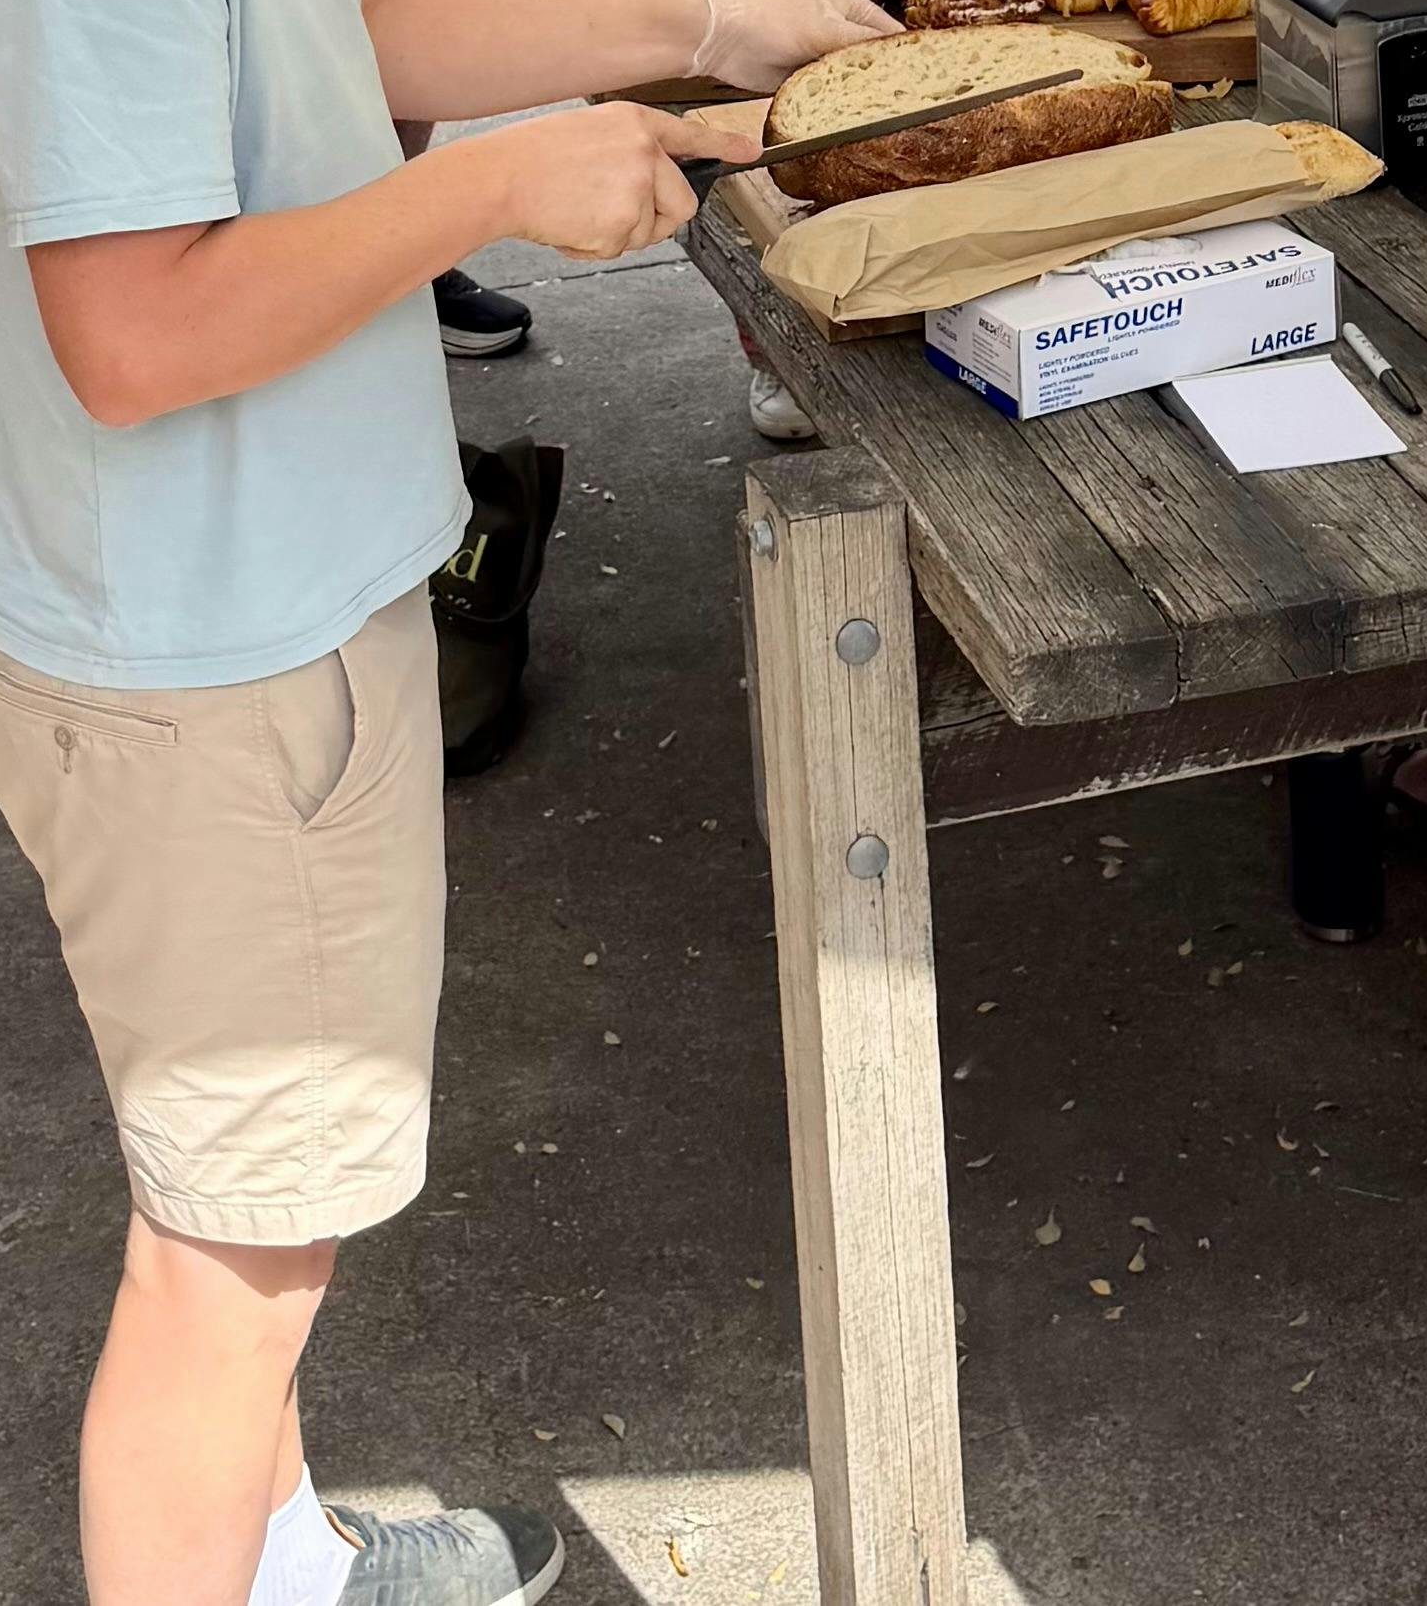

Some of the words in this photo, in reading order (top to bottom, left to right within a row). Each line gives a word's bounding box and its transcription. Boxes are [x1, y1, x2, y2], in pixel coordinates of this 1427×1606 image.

[1104, 245, 1302, 299] SAFETOUCH
[1035, 297, 1183, 350] SAFETOUCH
[1251, 322, 1317, 356] LARGE
